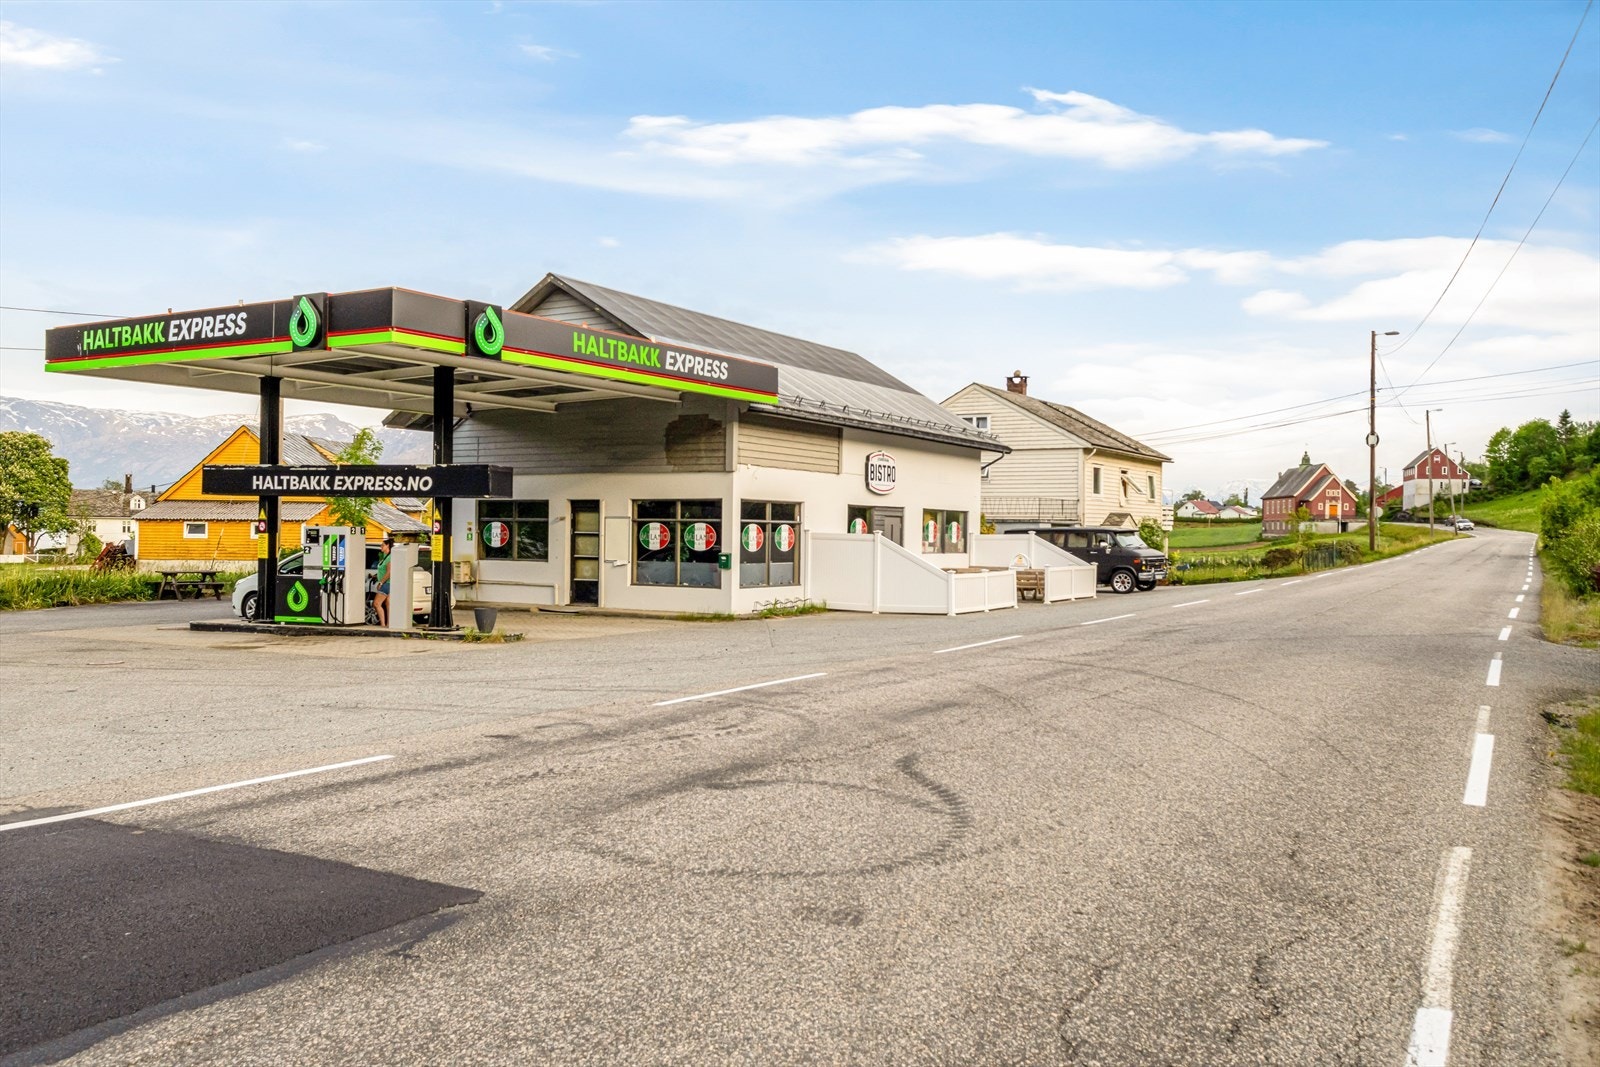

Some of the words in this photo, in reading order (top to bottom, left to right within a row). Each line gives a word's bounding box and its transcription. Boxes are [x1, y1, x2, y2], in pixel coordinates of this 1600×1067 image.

[83, 321, 165, 351] HALTBAKK
[168, 312, 248, 341] EXPRESS
[573, 331, 661, 368] HALTBAKK
[665, 350, 729, 380] EXPRESS
[252, 475, 330, 490] HALTBAKK
[333, 476, 433, 491] EXPRESS.NO
[869, 463, 896, 483] BISTRO
